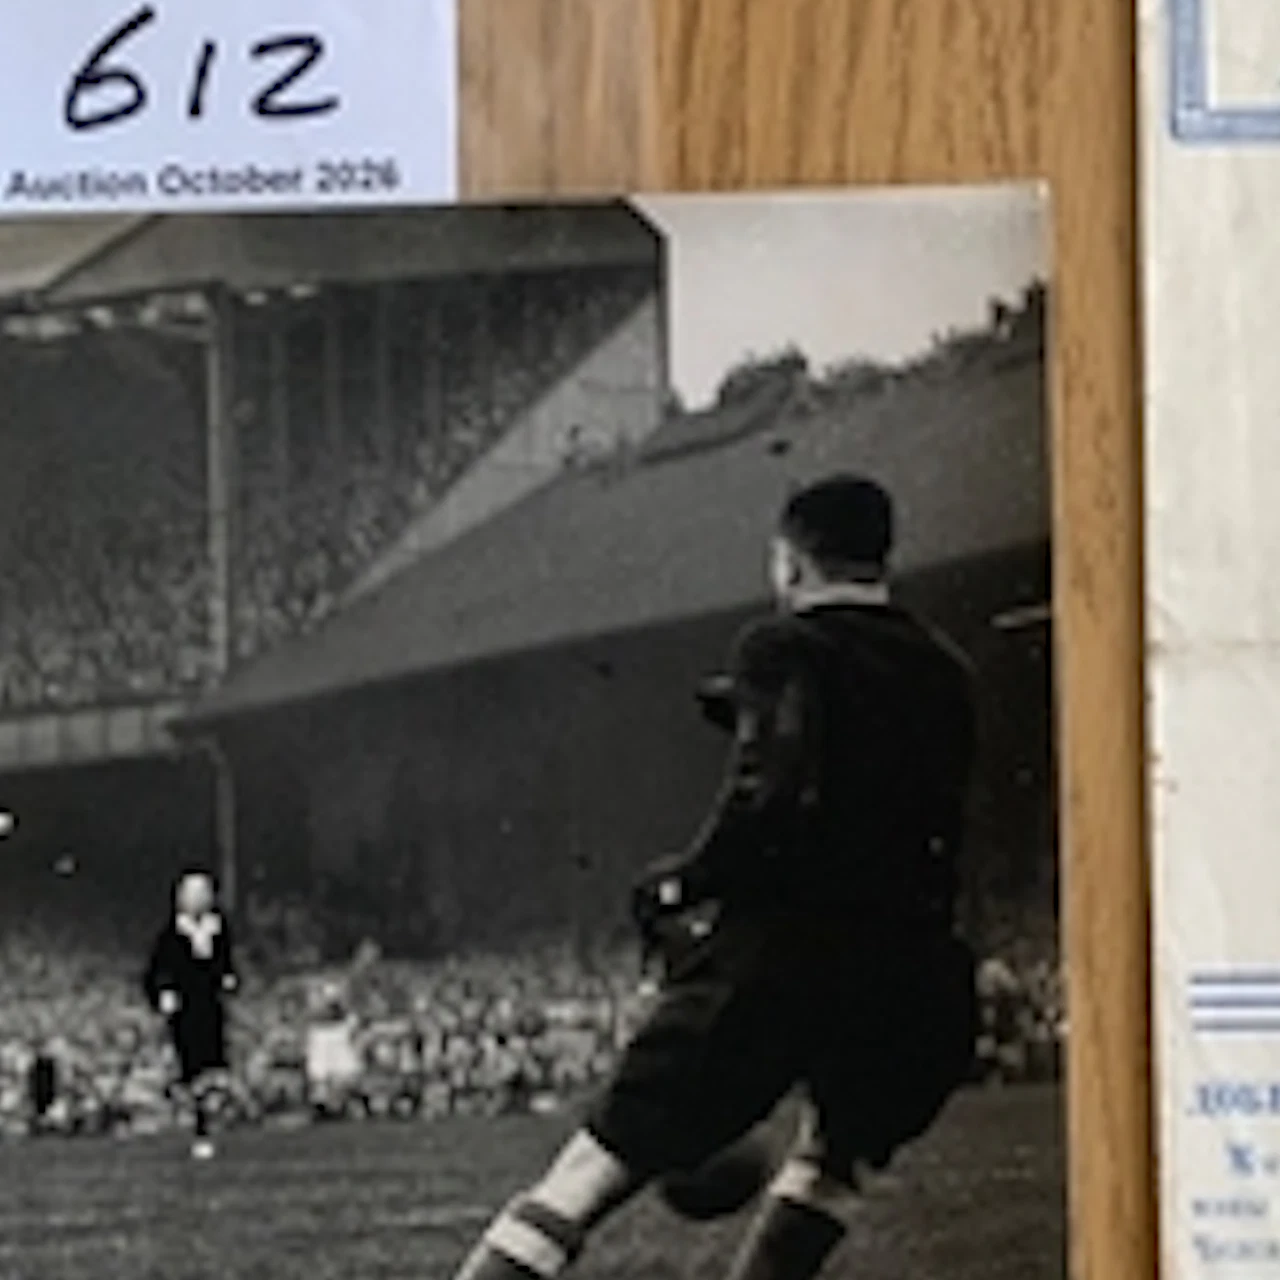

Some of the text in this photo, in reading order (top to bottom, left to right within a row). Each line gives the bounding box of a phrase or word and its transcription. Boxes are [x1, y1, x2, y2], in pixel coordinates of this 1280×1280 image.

[64, 5, 338, 132] 612
[5, 170, 148, 200] Auction
[157, 164, 303, 196] October
